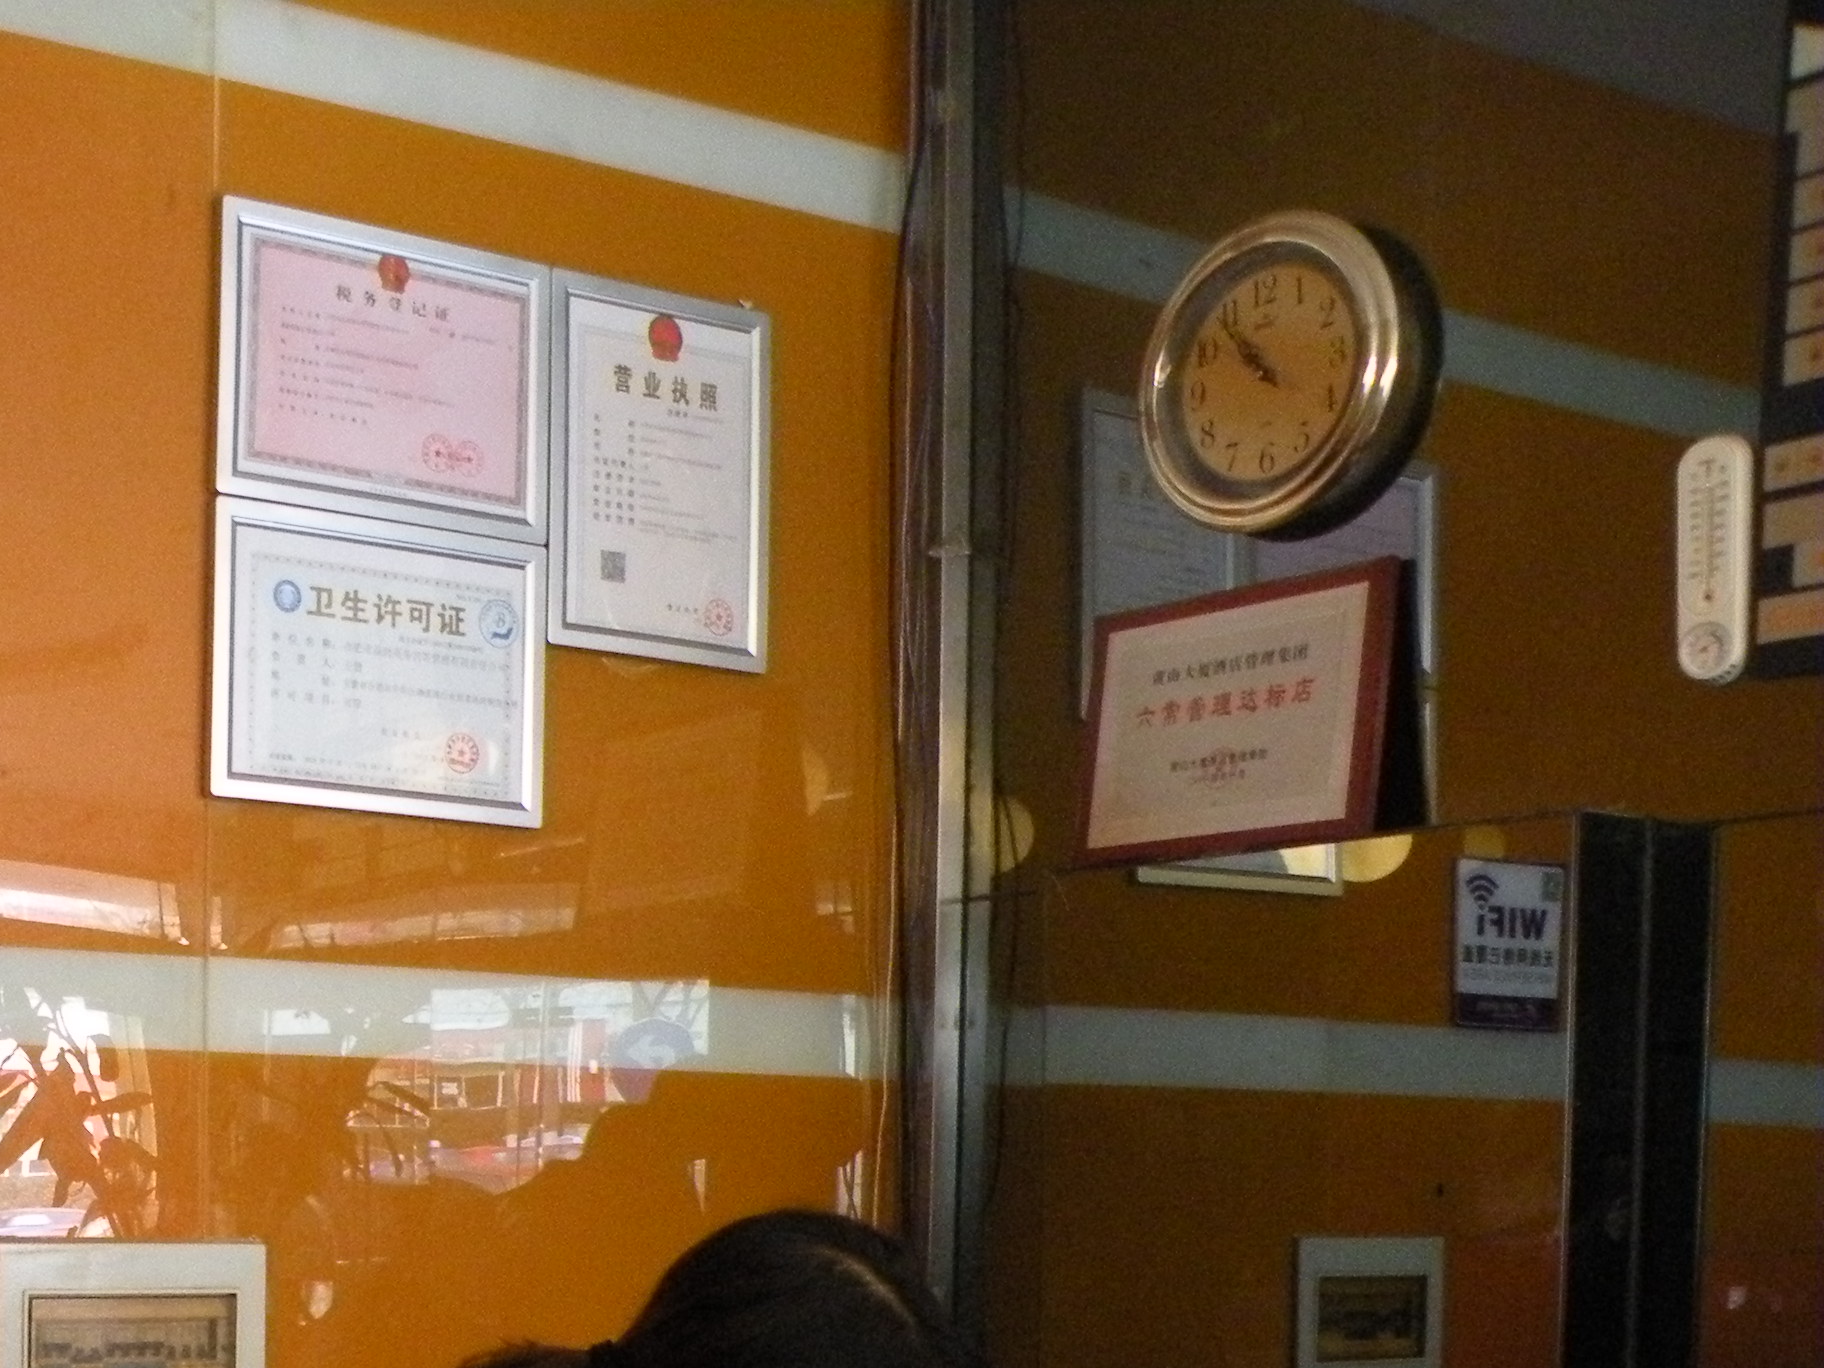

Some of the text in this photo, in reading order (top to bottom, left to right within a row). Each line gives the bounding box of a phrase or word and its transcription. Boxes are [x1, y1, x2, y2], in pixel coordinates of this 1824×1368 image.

[1251, 273, 1279, 308] 12
[1294, 273, 1304, 305] 1
[613, 363, 719, 412] 营业执照
[1189, 380, 1206, 410] 9
[1200, 419, 1215, 450] 8
[1225, 442, 1239, 472] 7
[1258, 441, 1275, 474] 6
[305, 585, 468, 638] 卫生许可证
